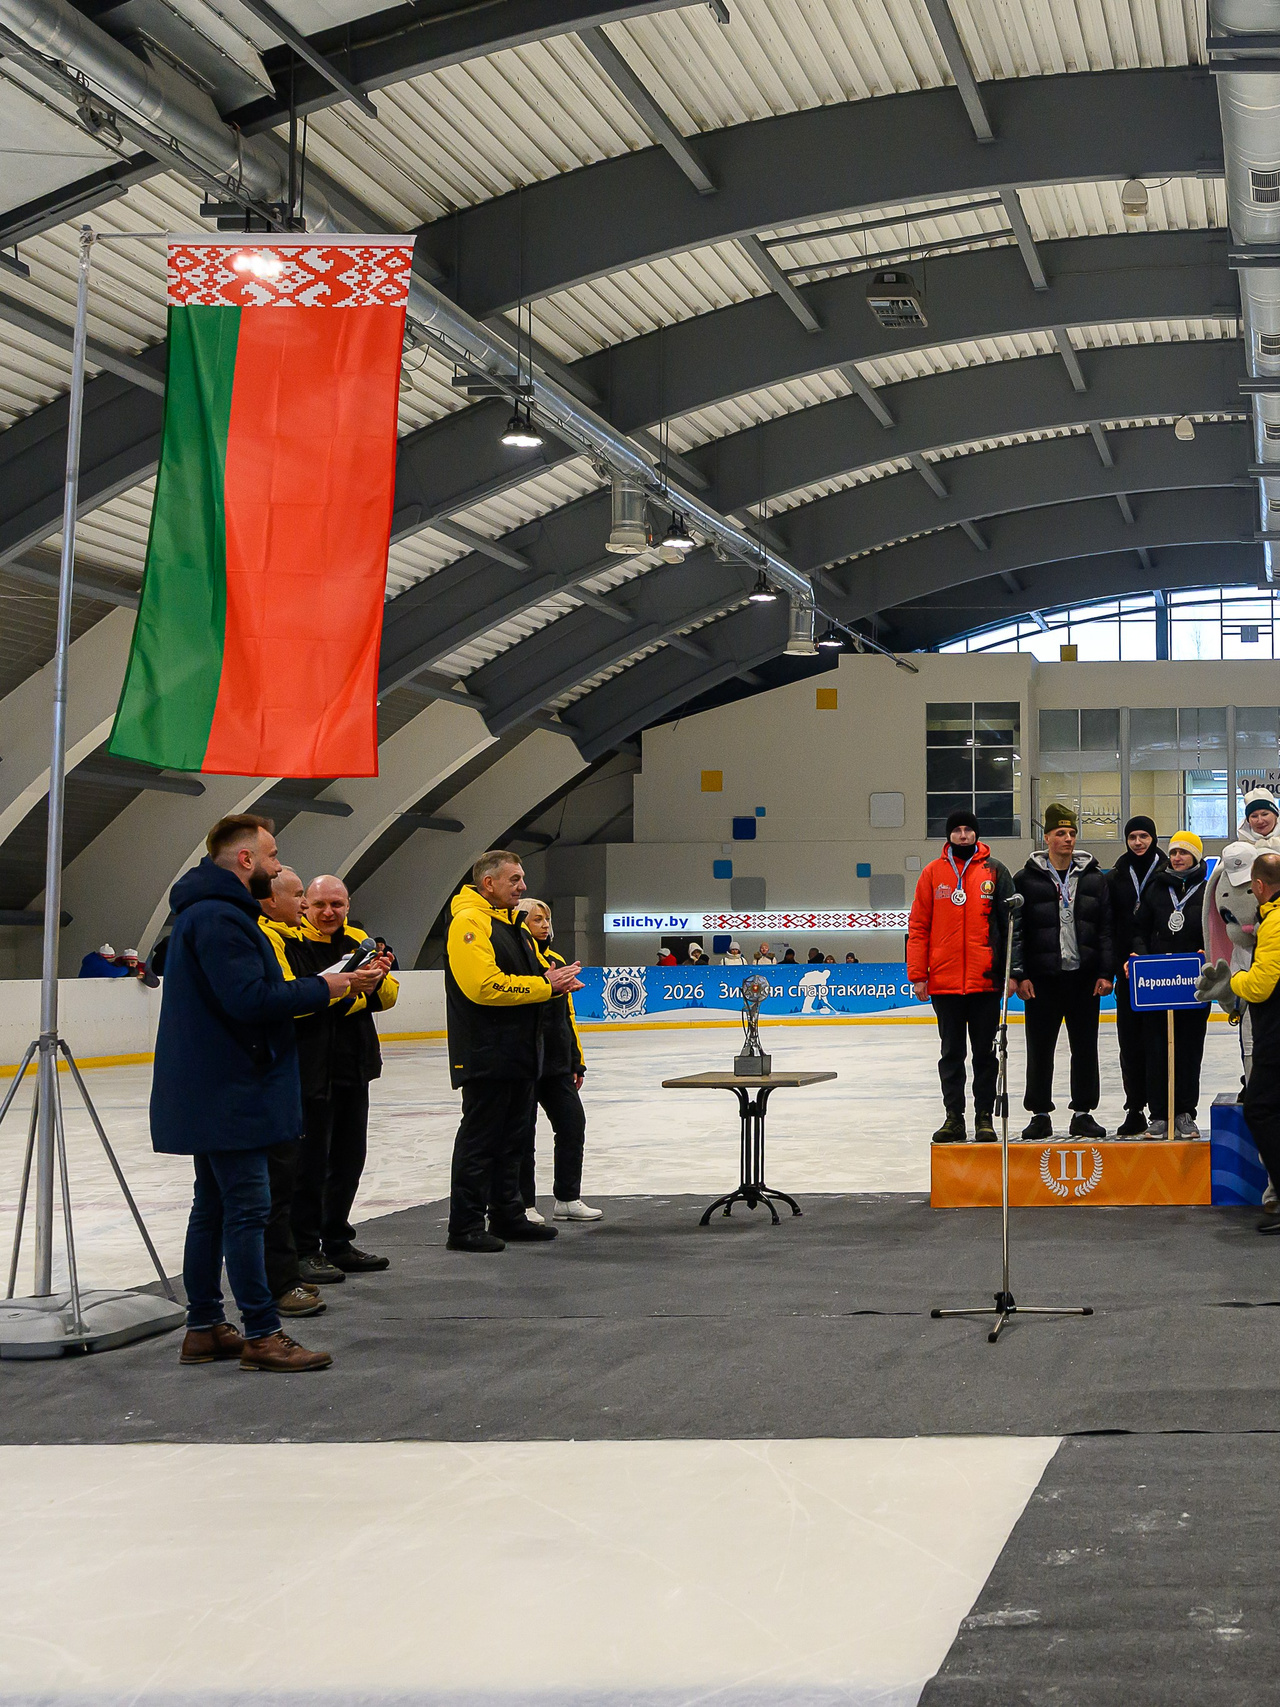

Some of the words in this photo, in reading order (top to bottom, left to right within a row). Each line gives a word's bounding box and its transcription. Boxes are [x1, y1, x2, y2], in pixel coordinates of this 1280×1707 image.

[612, 915, 689, 929] silichy.by
[492, 982, 531, 994] BELARUS
[663, 984, 705, 1000] 2026
[718, 983, 784, 999] Зияя
[787, 982, 896, 1001] спартакиада
[1056, 1150, 1086, 1181] II
